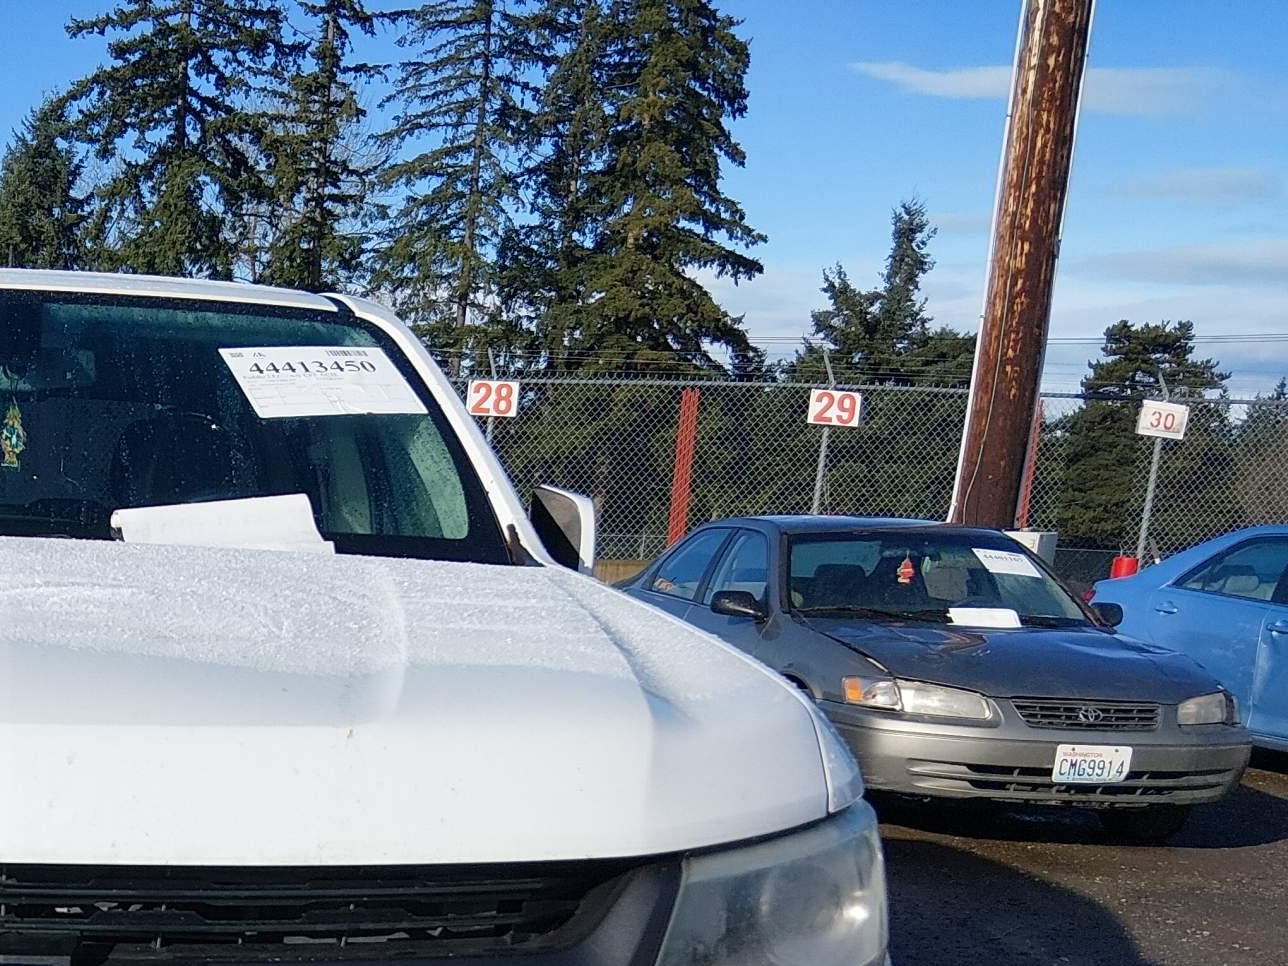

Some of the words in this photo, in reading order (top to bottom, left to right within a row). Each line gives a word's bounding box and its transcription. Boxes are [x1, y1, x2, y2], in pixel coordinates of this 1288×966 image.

[248, 360, 377, 375] 44413450
[470, 382, 513, 415] 28
[812, 391, 857, 425] 29
[1149, 410, 1176, 431] 30
[1058, 758, 1125, 778] CMG9914
